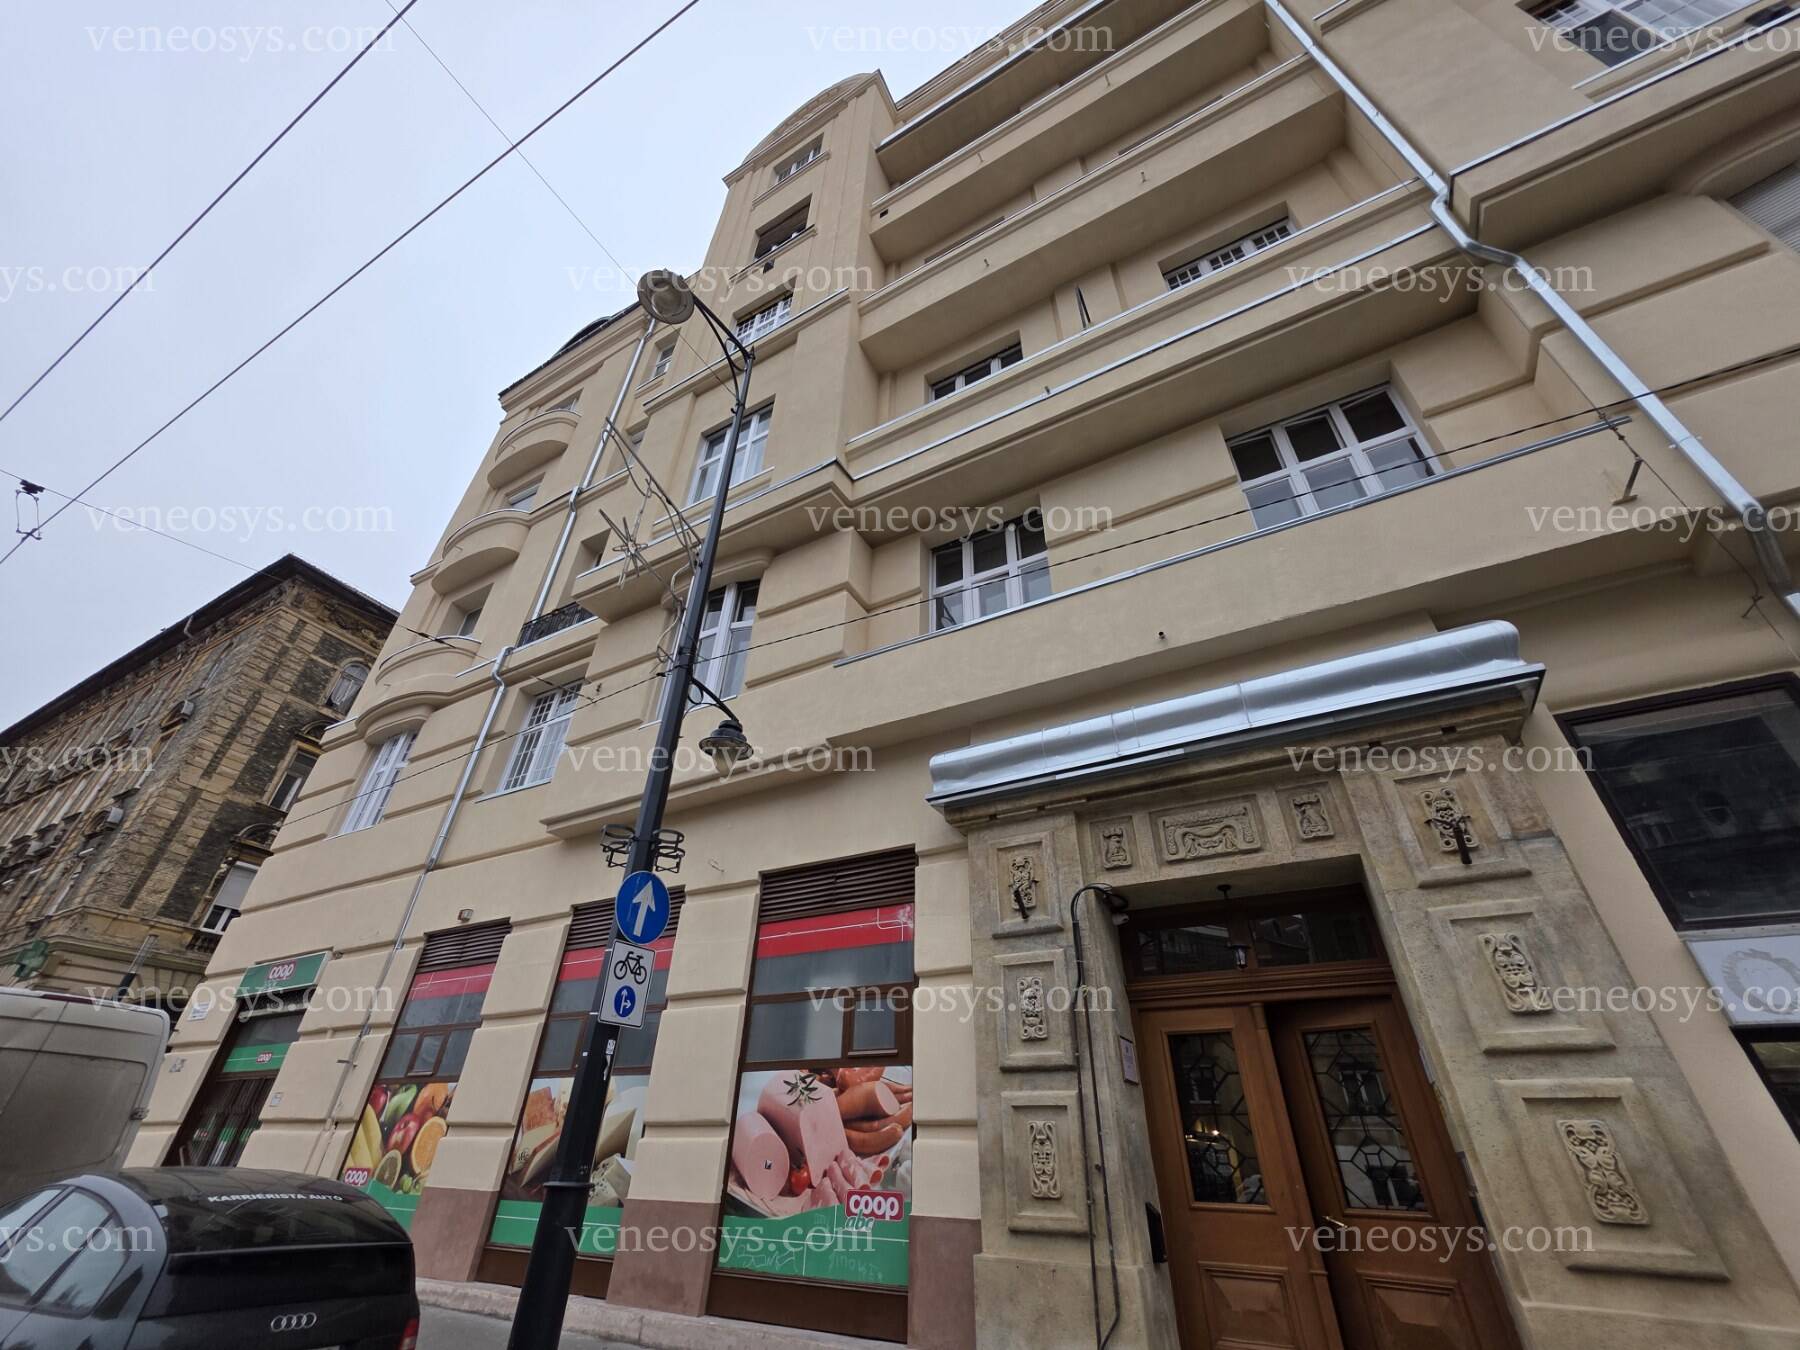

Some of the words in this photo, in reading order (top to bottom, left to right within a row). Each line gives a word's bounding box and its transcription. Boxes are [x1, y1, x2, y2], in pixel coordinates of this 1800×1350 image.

[208, 1193, 306, 1202] KARRIERISTA
[849, 1194, 900, 1221] coop
[845, 1208, 875, 1232] abc
